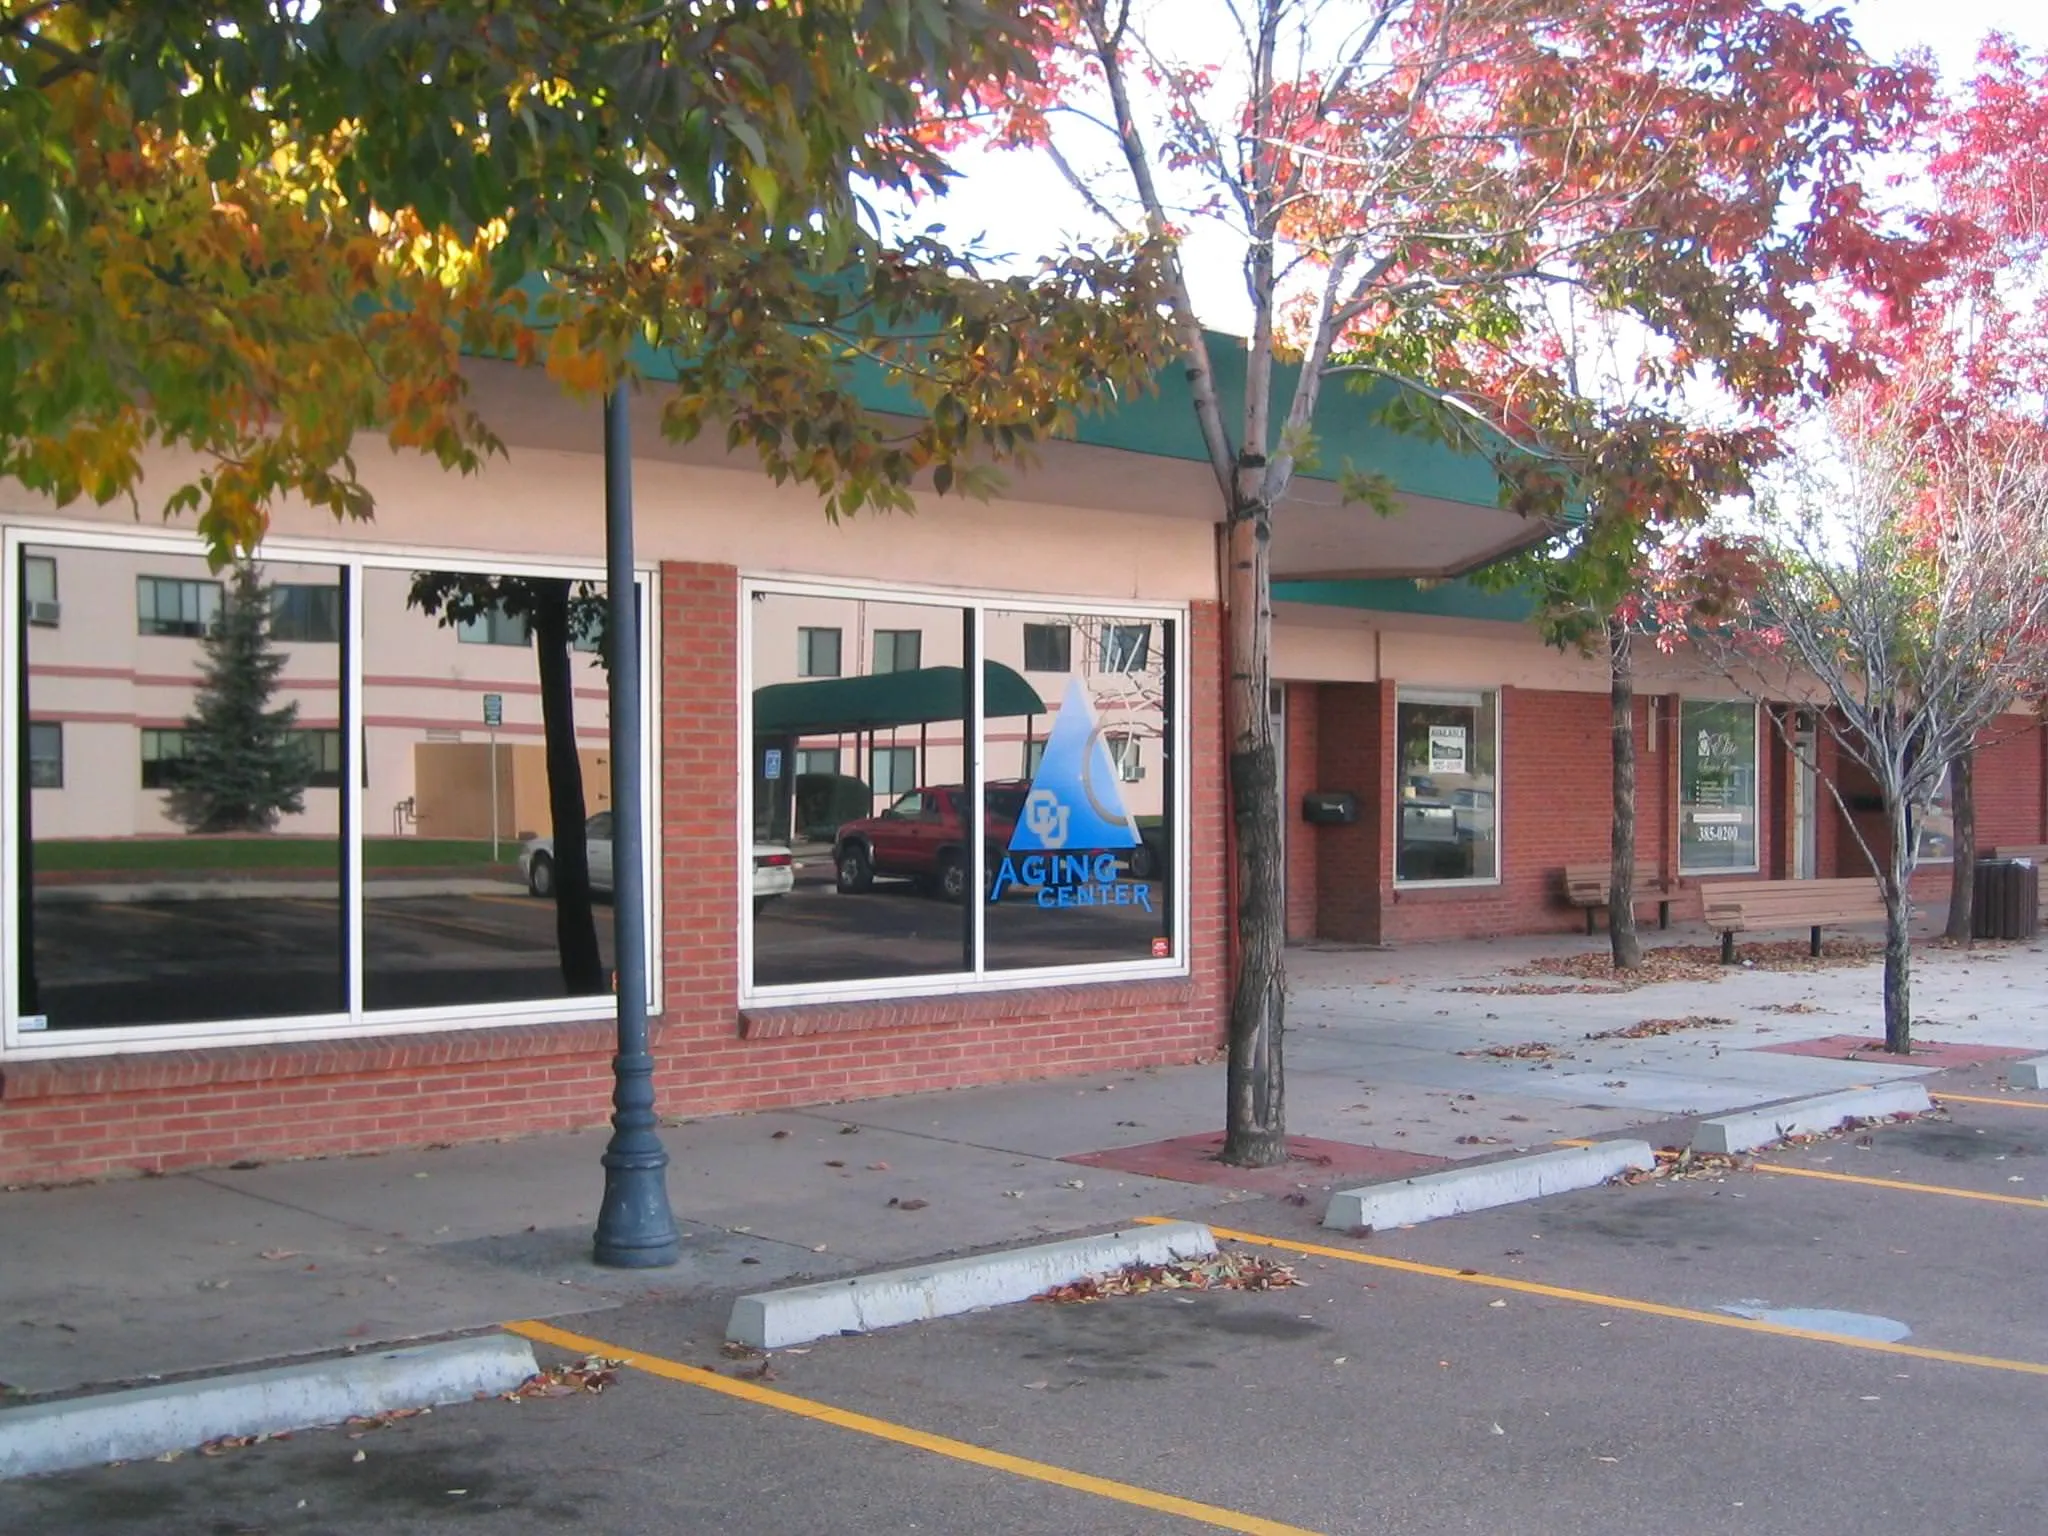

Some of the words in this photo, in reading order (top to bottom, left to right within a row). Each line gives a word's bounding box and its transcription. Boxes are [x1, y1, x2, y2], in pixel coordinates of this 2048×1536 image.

[1025, 789, 1070, 849] CU
[990, 853, 1118, 900] AGING
[1038, 884, 1153, 912] CENTER
